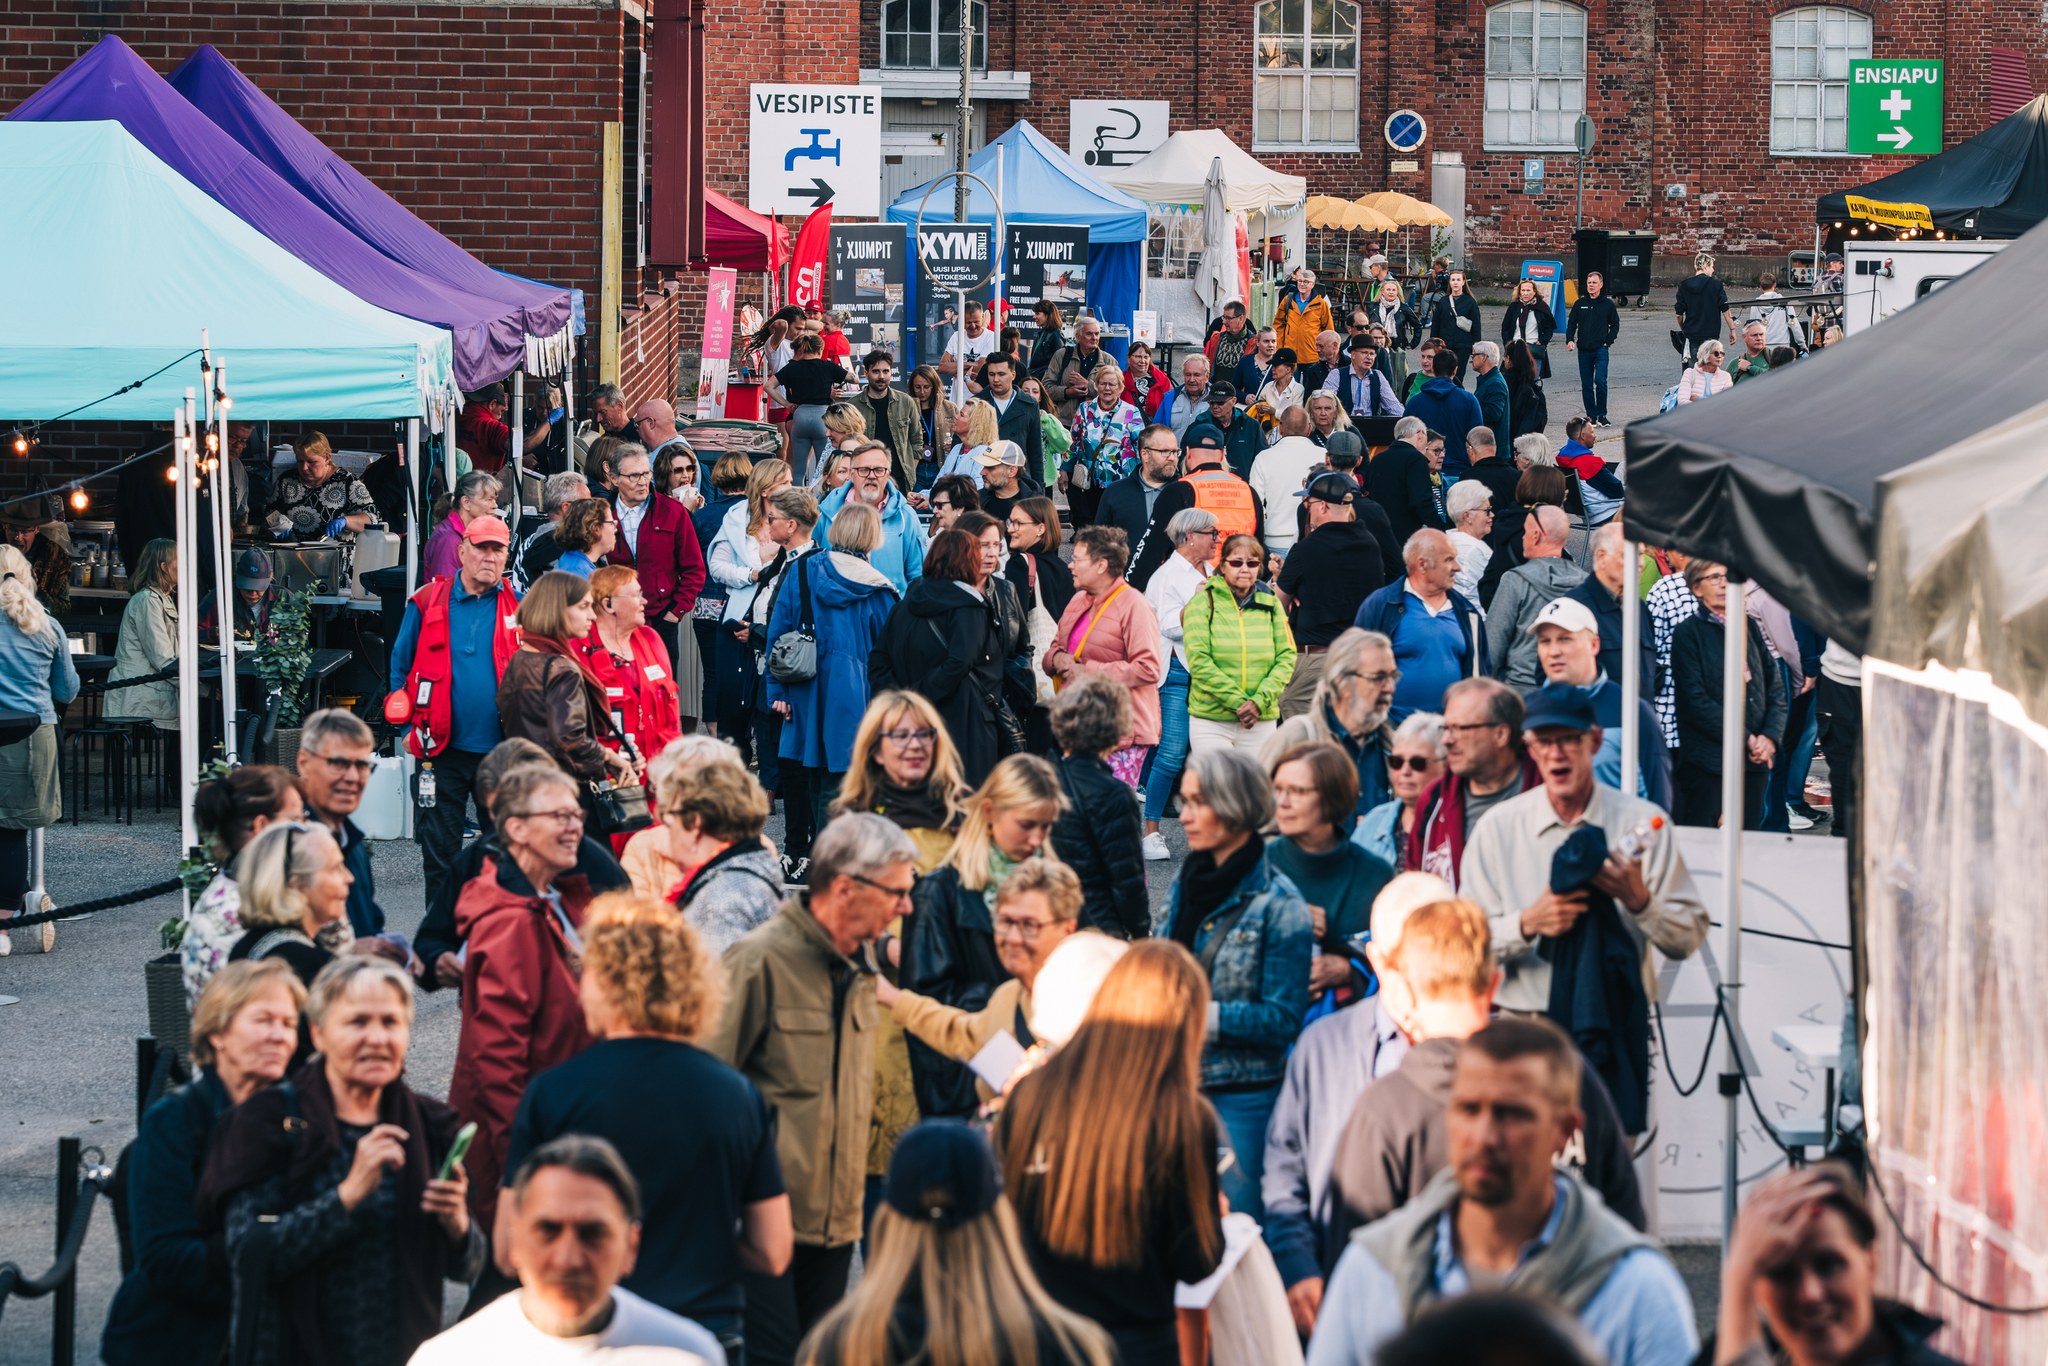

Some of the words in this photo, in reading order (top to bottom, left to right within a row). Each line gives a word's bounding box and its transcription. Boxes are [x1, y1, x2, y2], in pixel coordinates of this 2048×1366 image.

[1855, 67, 1938, 84] ENSIAPU
[756, 93, 875, 114] VESIPISTE
[1529, 161, 1540, 177] P
[846, 241, 893, 260] XJUMPIT
[918, 232, 978, 260] XYM
[977, 232, 987, 260] FITNESS
[1026, 241, 1075, 260] XJUMPIT
[1009, 285, 1031, 294] PARKOUR
[1009, 296, 1021, 304] FREE
